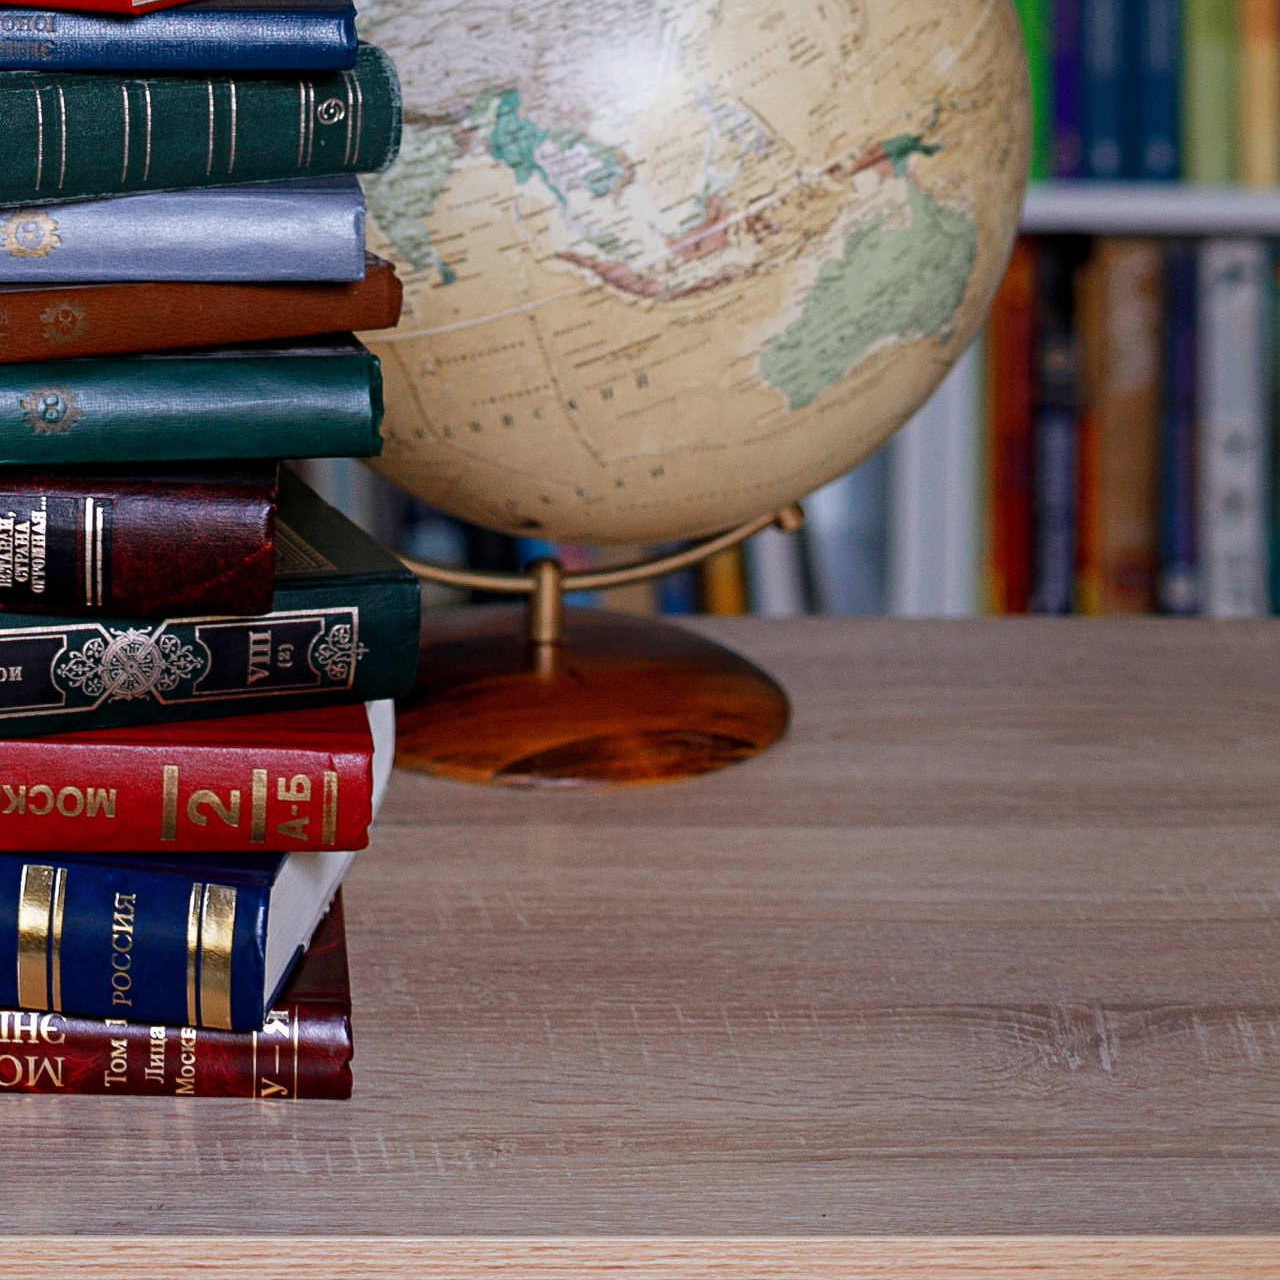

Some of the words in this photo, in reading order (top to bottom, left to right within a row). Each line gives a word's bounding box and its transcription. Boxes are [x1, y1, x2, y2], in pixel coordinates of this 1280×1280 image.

[14, 520, 31, 583] СТРАНА
[246, 630, 272, 686] VIII
[277, 643, 295, 668] (2)
[186, 789, 241, 828] 2
[276, 773, 312, 841] А-Б
[111, 892, 137, 1007] РОССИЯ
[263, 1010, 290, 1039] Я
[104, 1038, 128, 1087] Том
[144, 1025, 168, 1084] Лица
